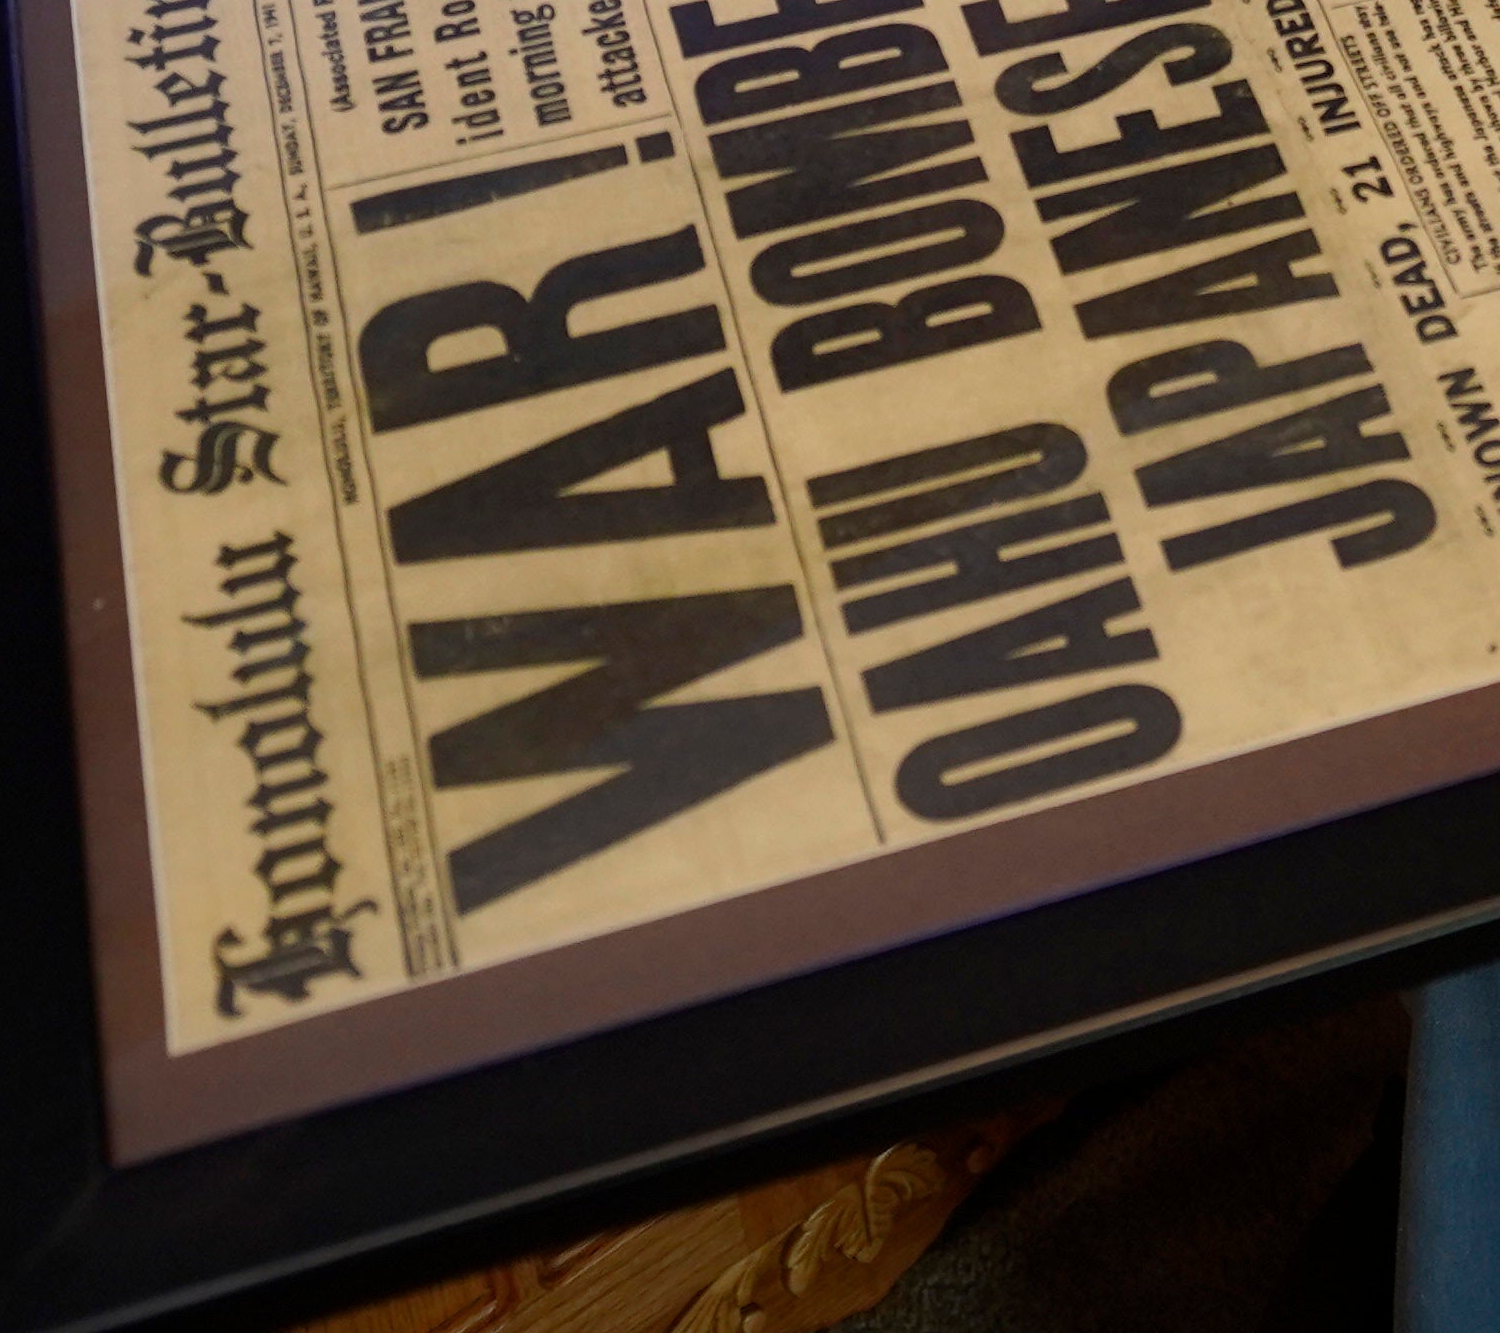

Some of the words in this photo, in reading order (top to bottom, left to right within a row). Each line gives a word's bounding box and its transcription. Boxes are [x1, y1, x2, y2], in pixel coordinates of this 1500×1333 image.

[261, 3, 278, 29] 1941
[269, 50, 293, 114] DECEMBER
[315, 10, 356, 113] (Associated
[508, 3, 573, 127] morning
[1340, 34, 1379, 91] STREETS
[372, 69, 430, 135] SAN
[445, 50, 505, 146] ident
[1367, 93, 1391, 118] OFF
[1341, 155, 1394, 203] 21
[1383, 121, 1424, 185] ORDERED
[1413, 187, 1462, 265] CIVILIANS
[1379, 222, 1458, 344] DEAD,
[311, 308, 329, 327] OF
[805, 421, 1183, 823] OAHU
[181, 530, 379, 1020] Honolulu
